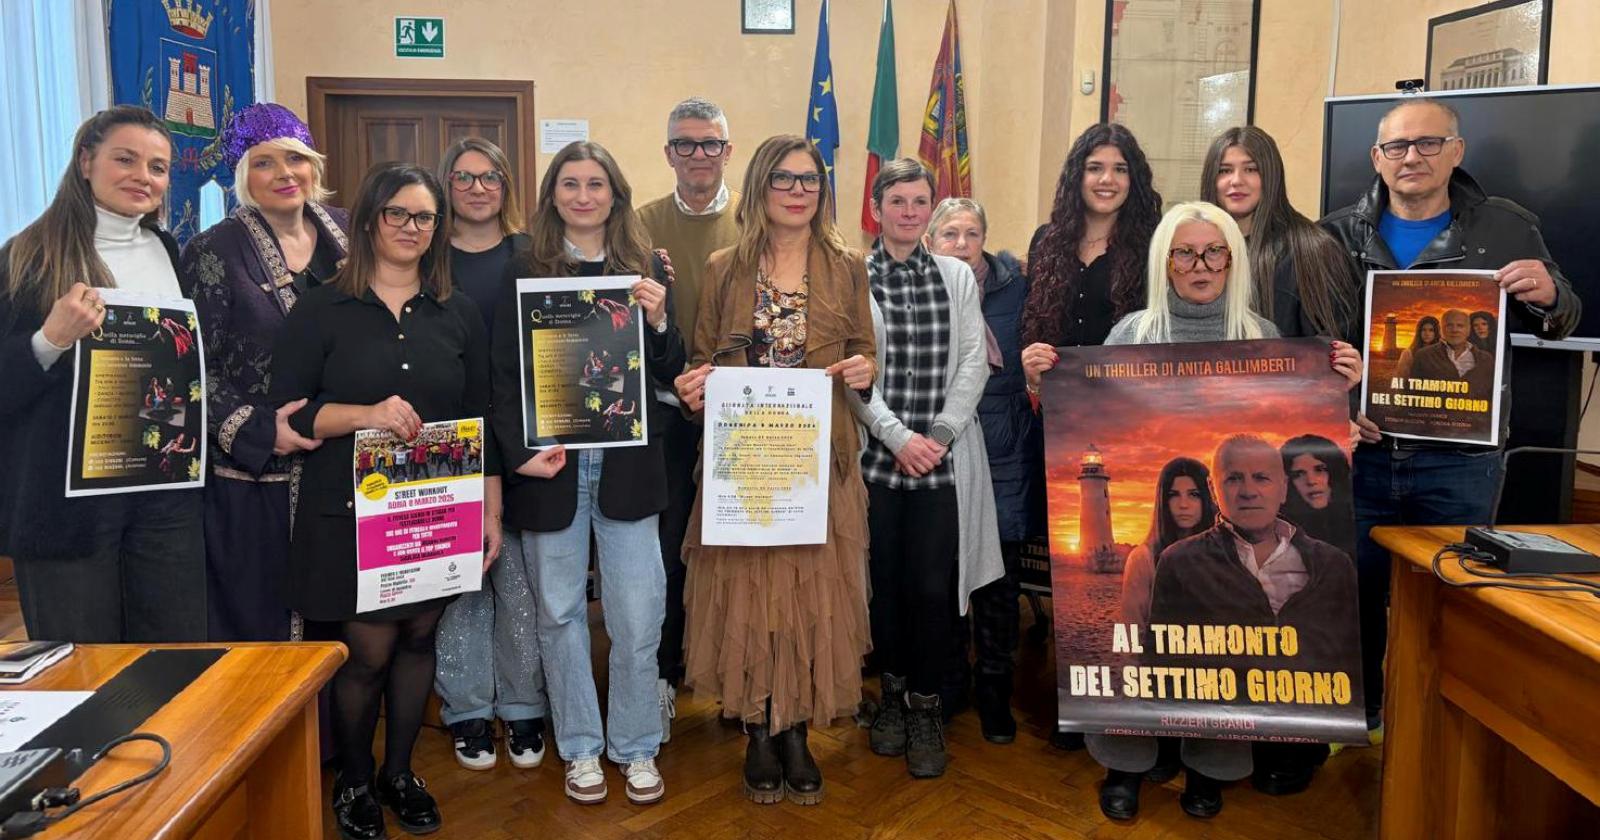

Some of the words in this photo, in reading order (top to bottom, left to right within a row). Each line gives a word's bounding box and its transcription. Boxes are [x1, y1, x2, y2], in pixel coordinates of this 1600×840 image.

[1085, 364, 1100, 378] UN
[1104, 362, 1158, 378] THRILLER
[1161, 362, 1173, 376] DI
[1178, 360, 1212, 376] ANITA
[1216, 357, 1296, 375] GALLIMBERTI
[1390, 377, 1404, 390] AL
[1408, 378, 1469, 393] TRAMONTO
[1371, 393, 1391, 405] DEL
[1394, 394, 1442, 408] SETTIMO
[1445, 399, 1488, 412] GIORNO
[1112, 623, 1143, 653] AL
[1151, 624, 1298, 656] TRAMONTO
[1070, 665, 1114, 697] DEL
[1122, 665, 1237, 701] SETTIMO
[1247, 669, 1351, 705] GIORNO
